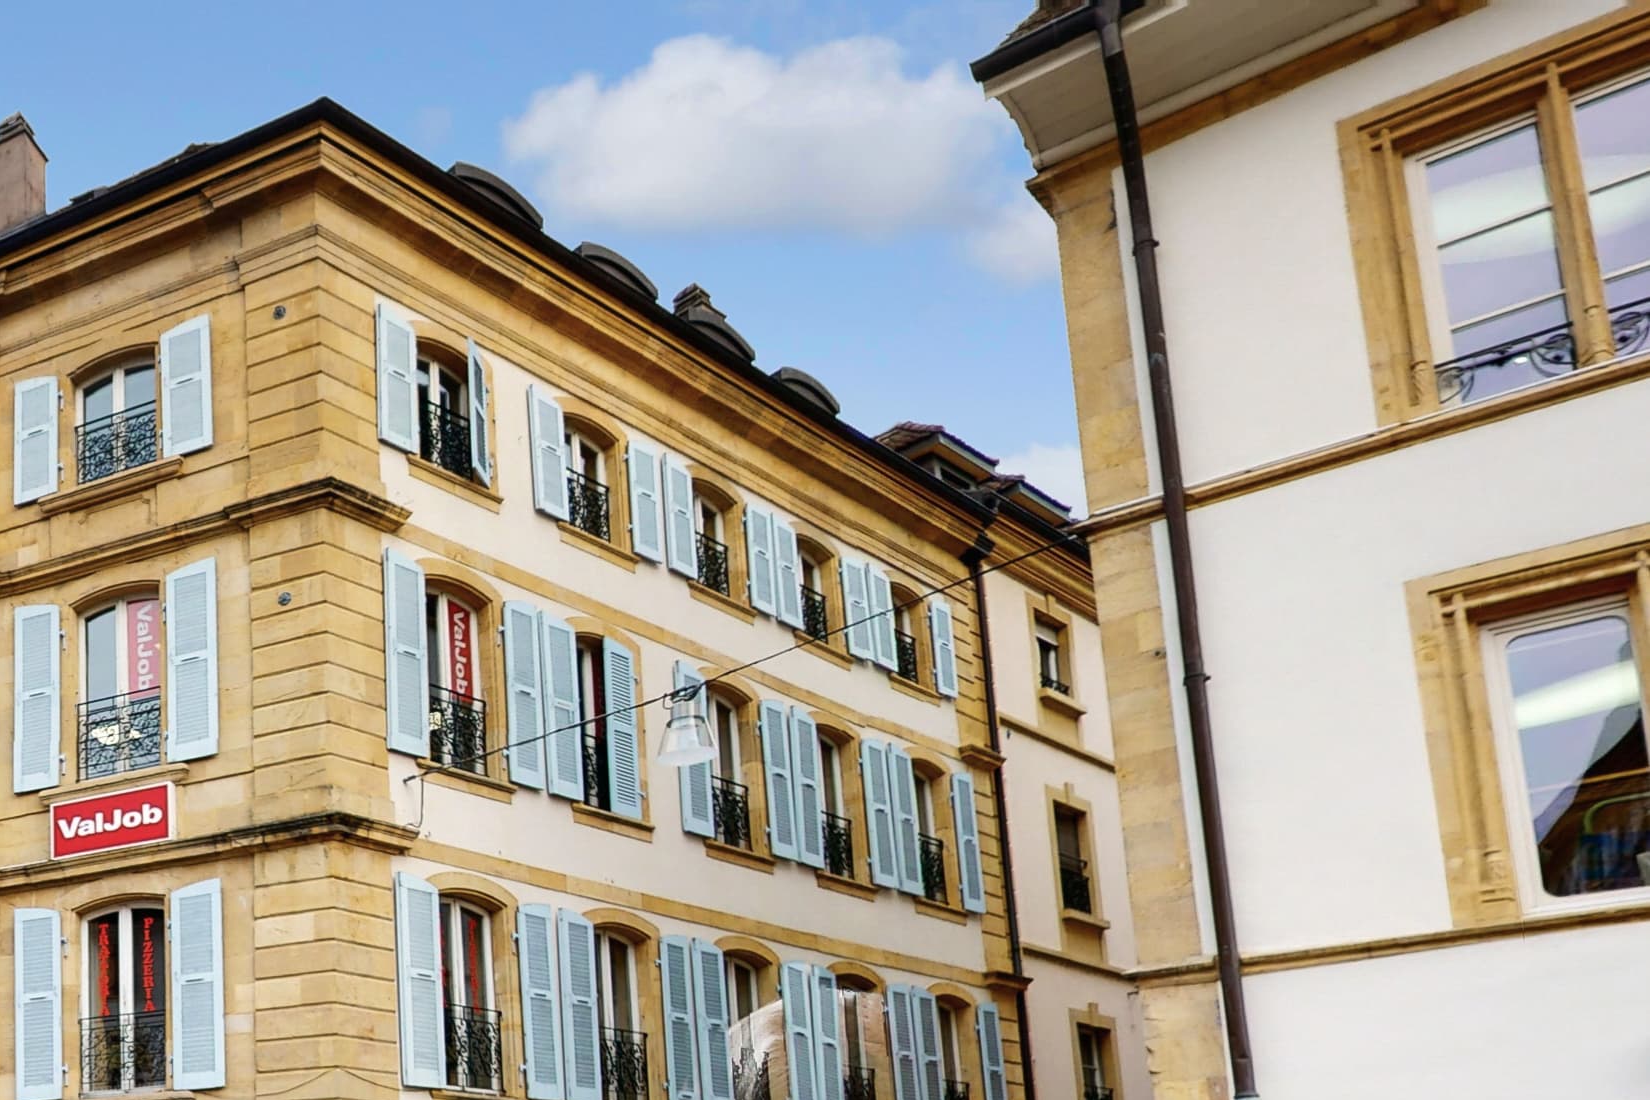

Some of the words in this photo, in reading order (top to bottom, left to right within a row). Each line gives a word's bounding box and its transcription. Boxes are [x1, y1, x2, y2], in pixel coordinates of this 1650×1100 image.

[137, 603, 153, 690] ValJob
[454, 611, 468, 694] ValJob
[57, 803, 163, 839] ValJob
[142, 917, 156, 1011] PIZZERIA
